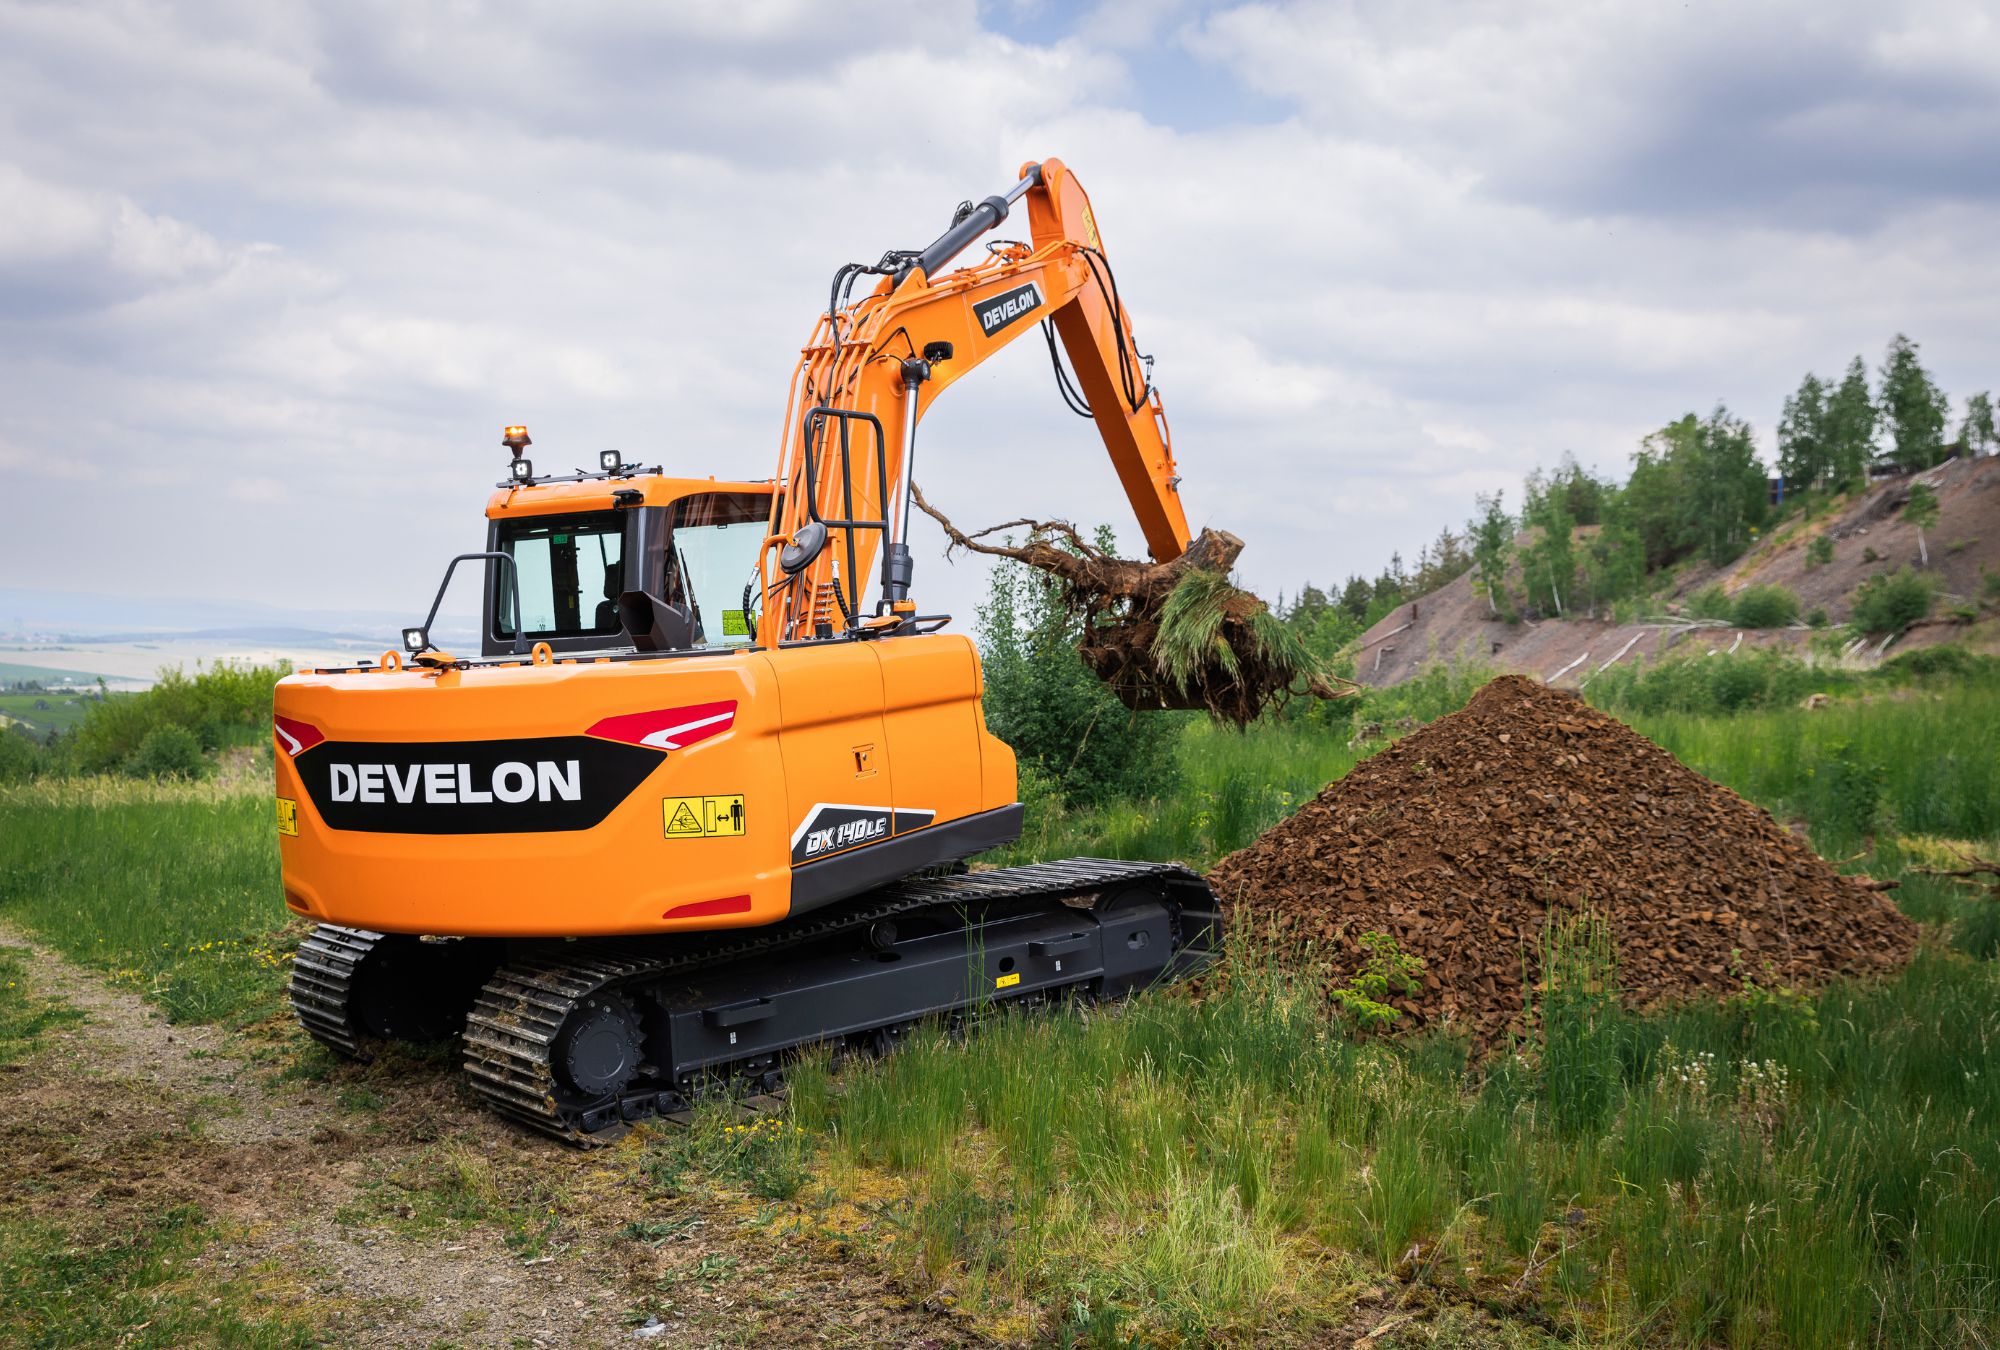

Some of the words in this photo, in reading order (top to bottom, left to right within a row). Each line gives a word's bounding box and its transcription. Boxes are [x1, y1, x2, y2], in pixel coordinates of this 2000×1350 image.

[983, 290, 1035, 330] DEVELON
[330, 760, 581, 803] DEVELON
[806, 827, 835, 856] DX
